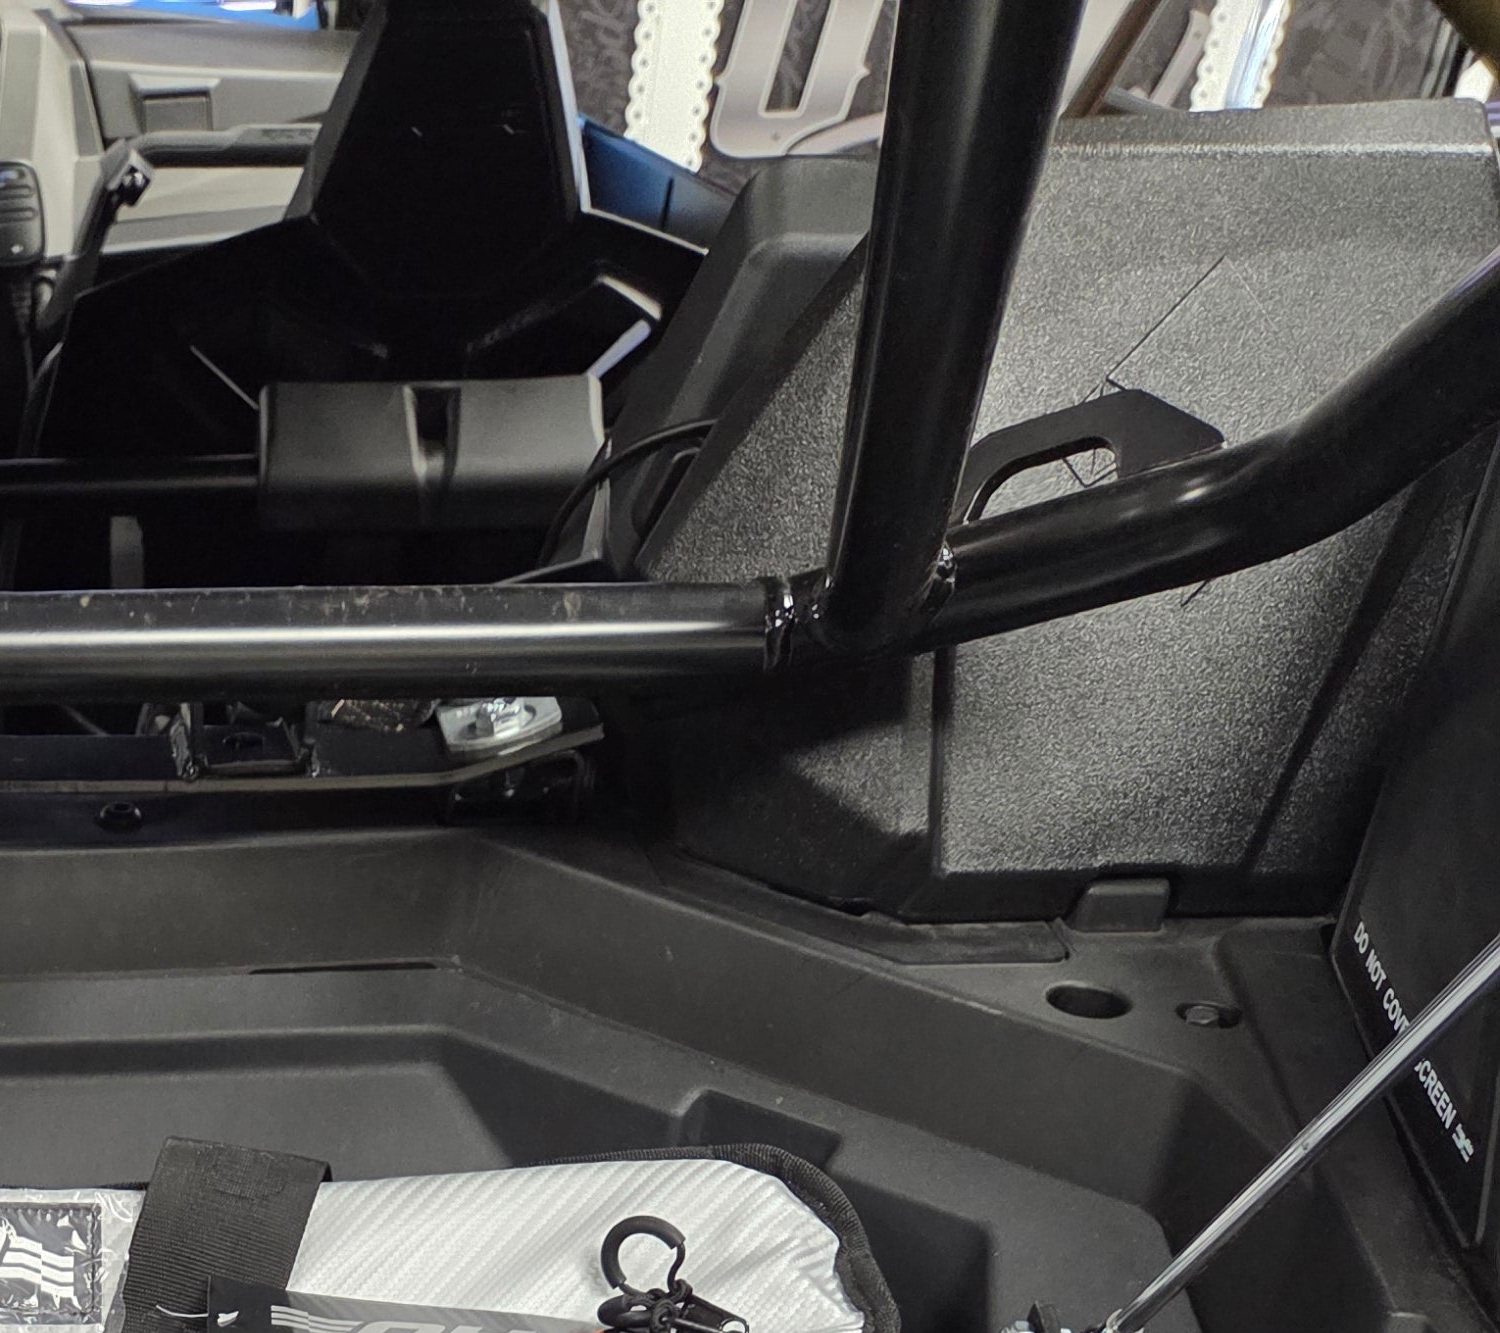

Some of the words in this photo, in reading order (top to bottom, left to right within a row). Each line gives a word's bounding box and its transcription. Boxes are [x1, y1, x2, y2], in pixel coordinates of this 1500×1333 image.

[1354, 921, 1369, 954] DO
[1365, 948, 1387, 991] NOT
[1383, 987, 1411, 1035] COVE
